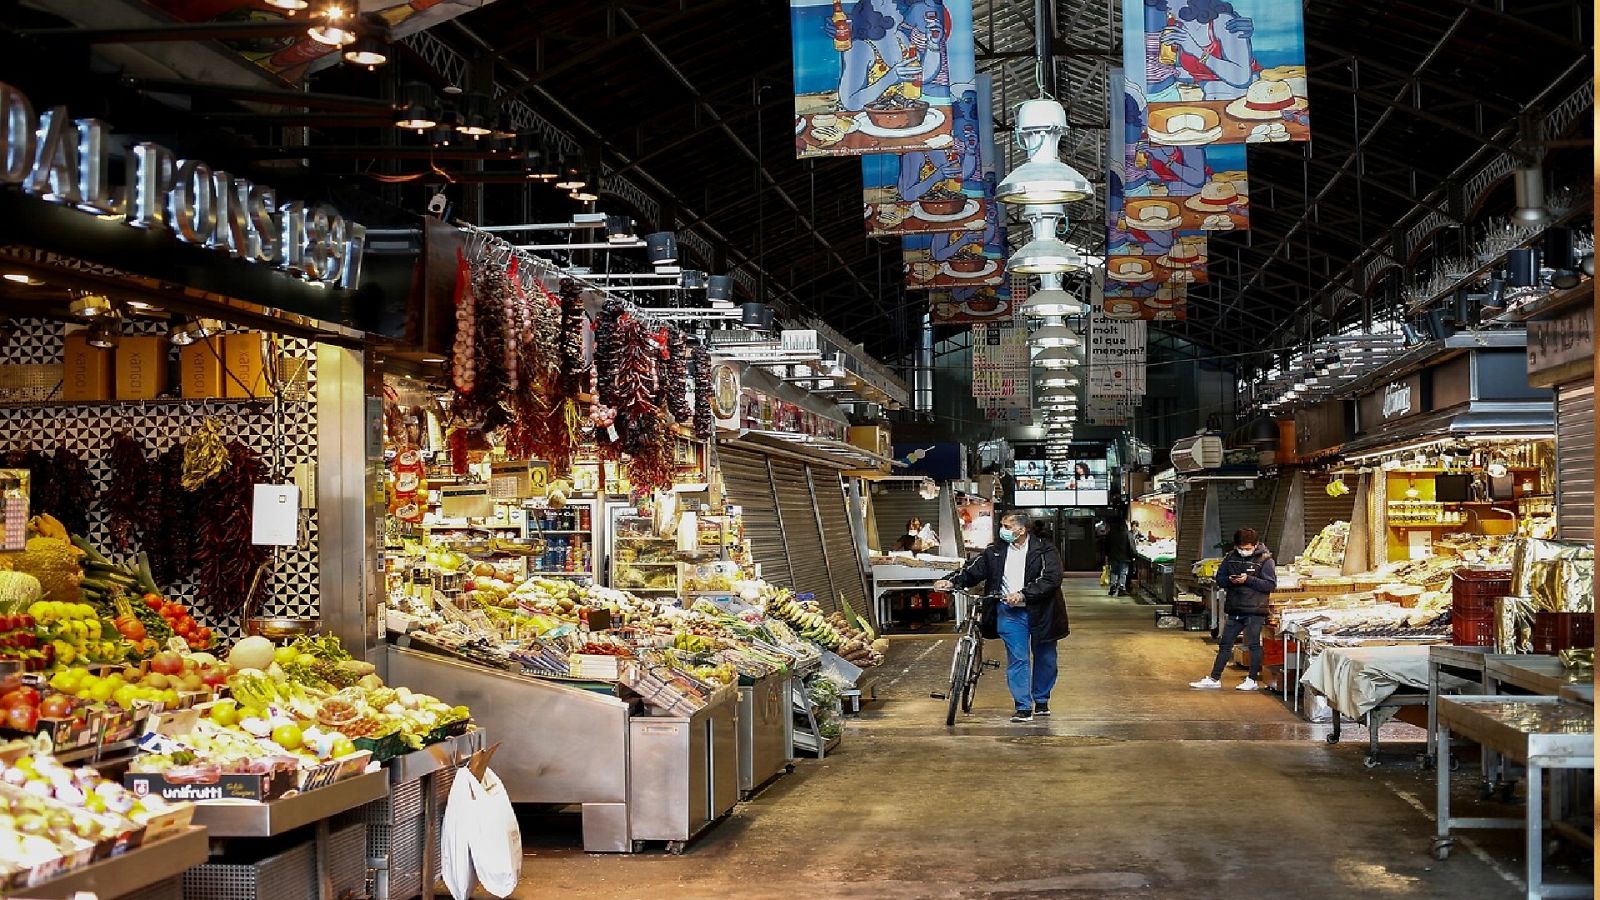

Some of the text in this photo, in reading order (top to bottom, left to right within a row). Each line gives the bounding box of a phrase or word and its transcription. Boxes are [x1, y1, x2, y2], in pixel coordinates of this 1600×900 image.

[126, 142, 277, 262] PONS
[1093, 325, 1118, 334] molt
[1093, 336, 1126, 346] el que
[1093, 347, 1145, 357] mengem?
[162, 784, 222, 799] unifrutti
